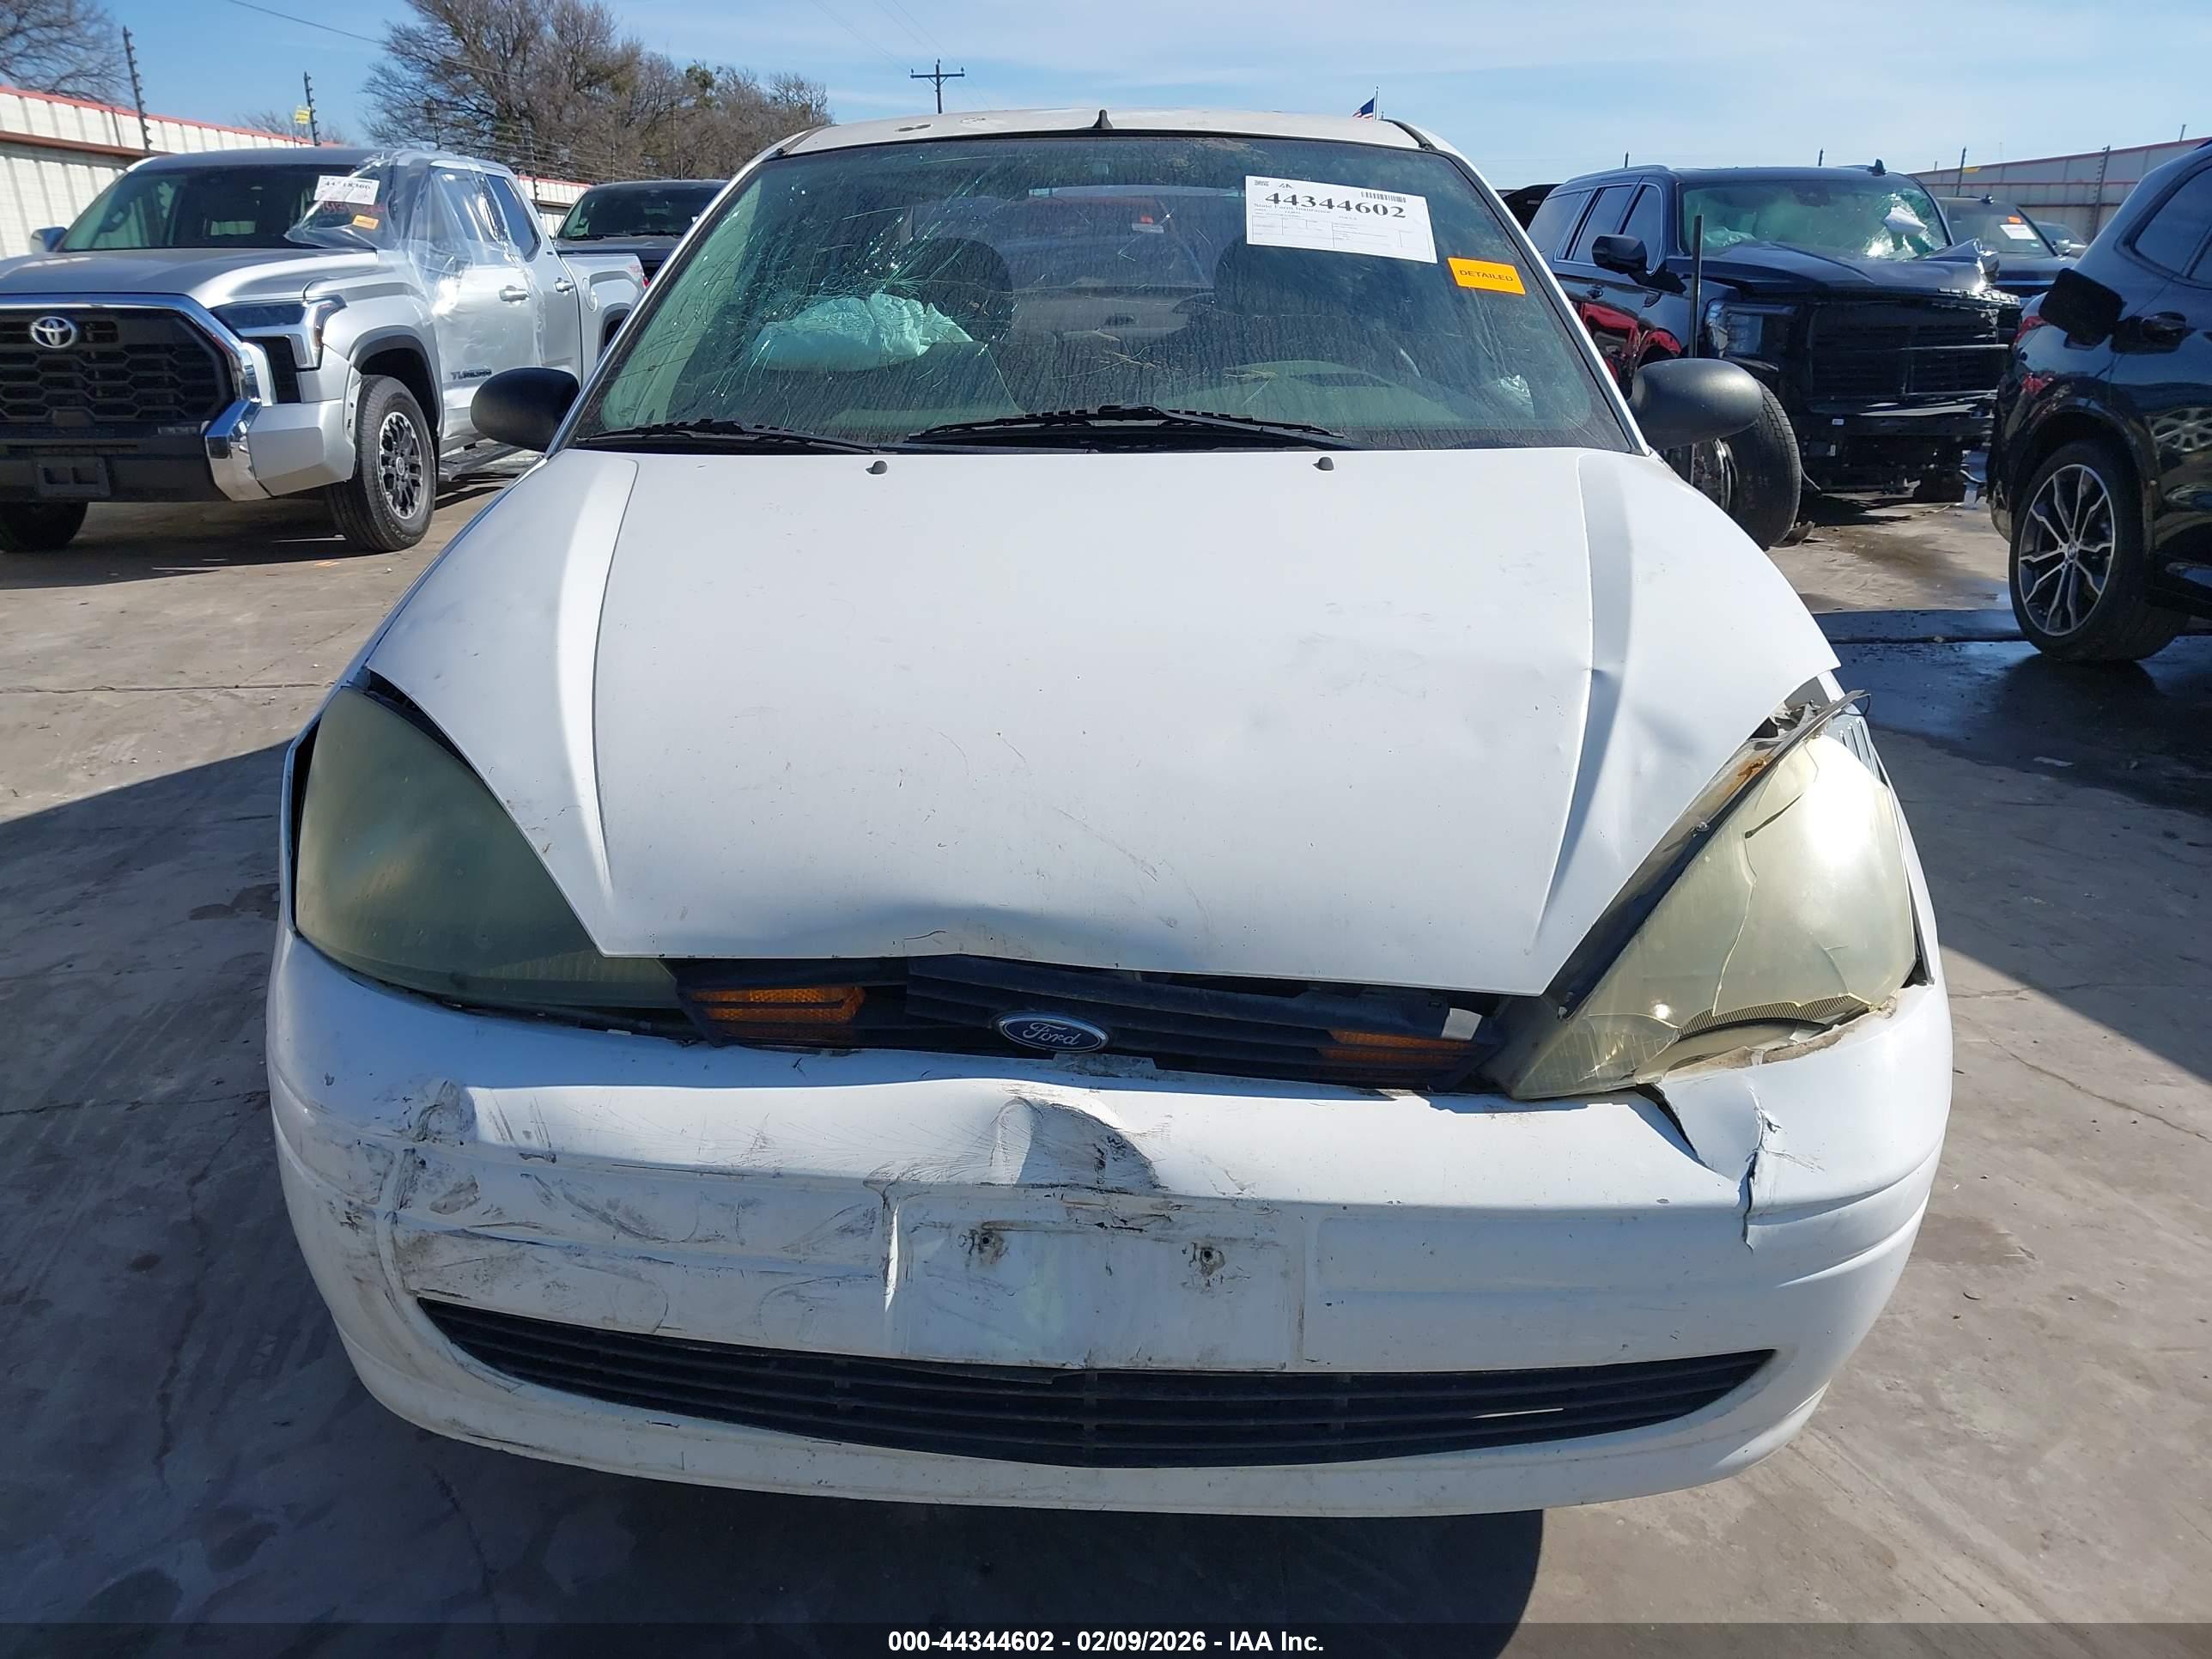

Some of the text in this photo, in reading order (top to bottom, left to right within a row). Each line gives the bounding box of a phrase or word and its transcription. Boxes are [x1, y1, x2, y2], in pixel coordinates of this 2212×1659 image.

[1265, 192, 1407, 218] 44344602
[1459, 270, 1514, 282] DETAILED
[1022, 1022, 1081, 1046] Ford
